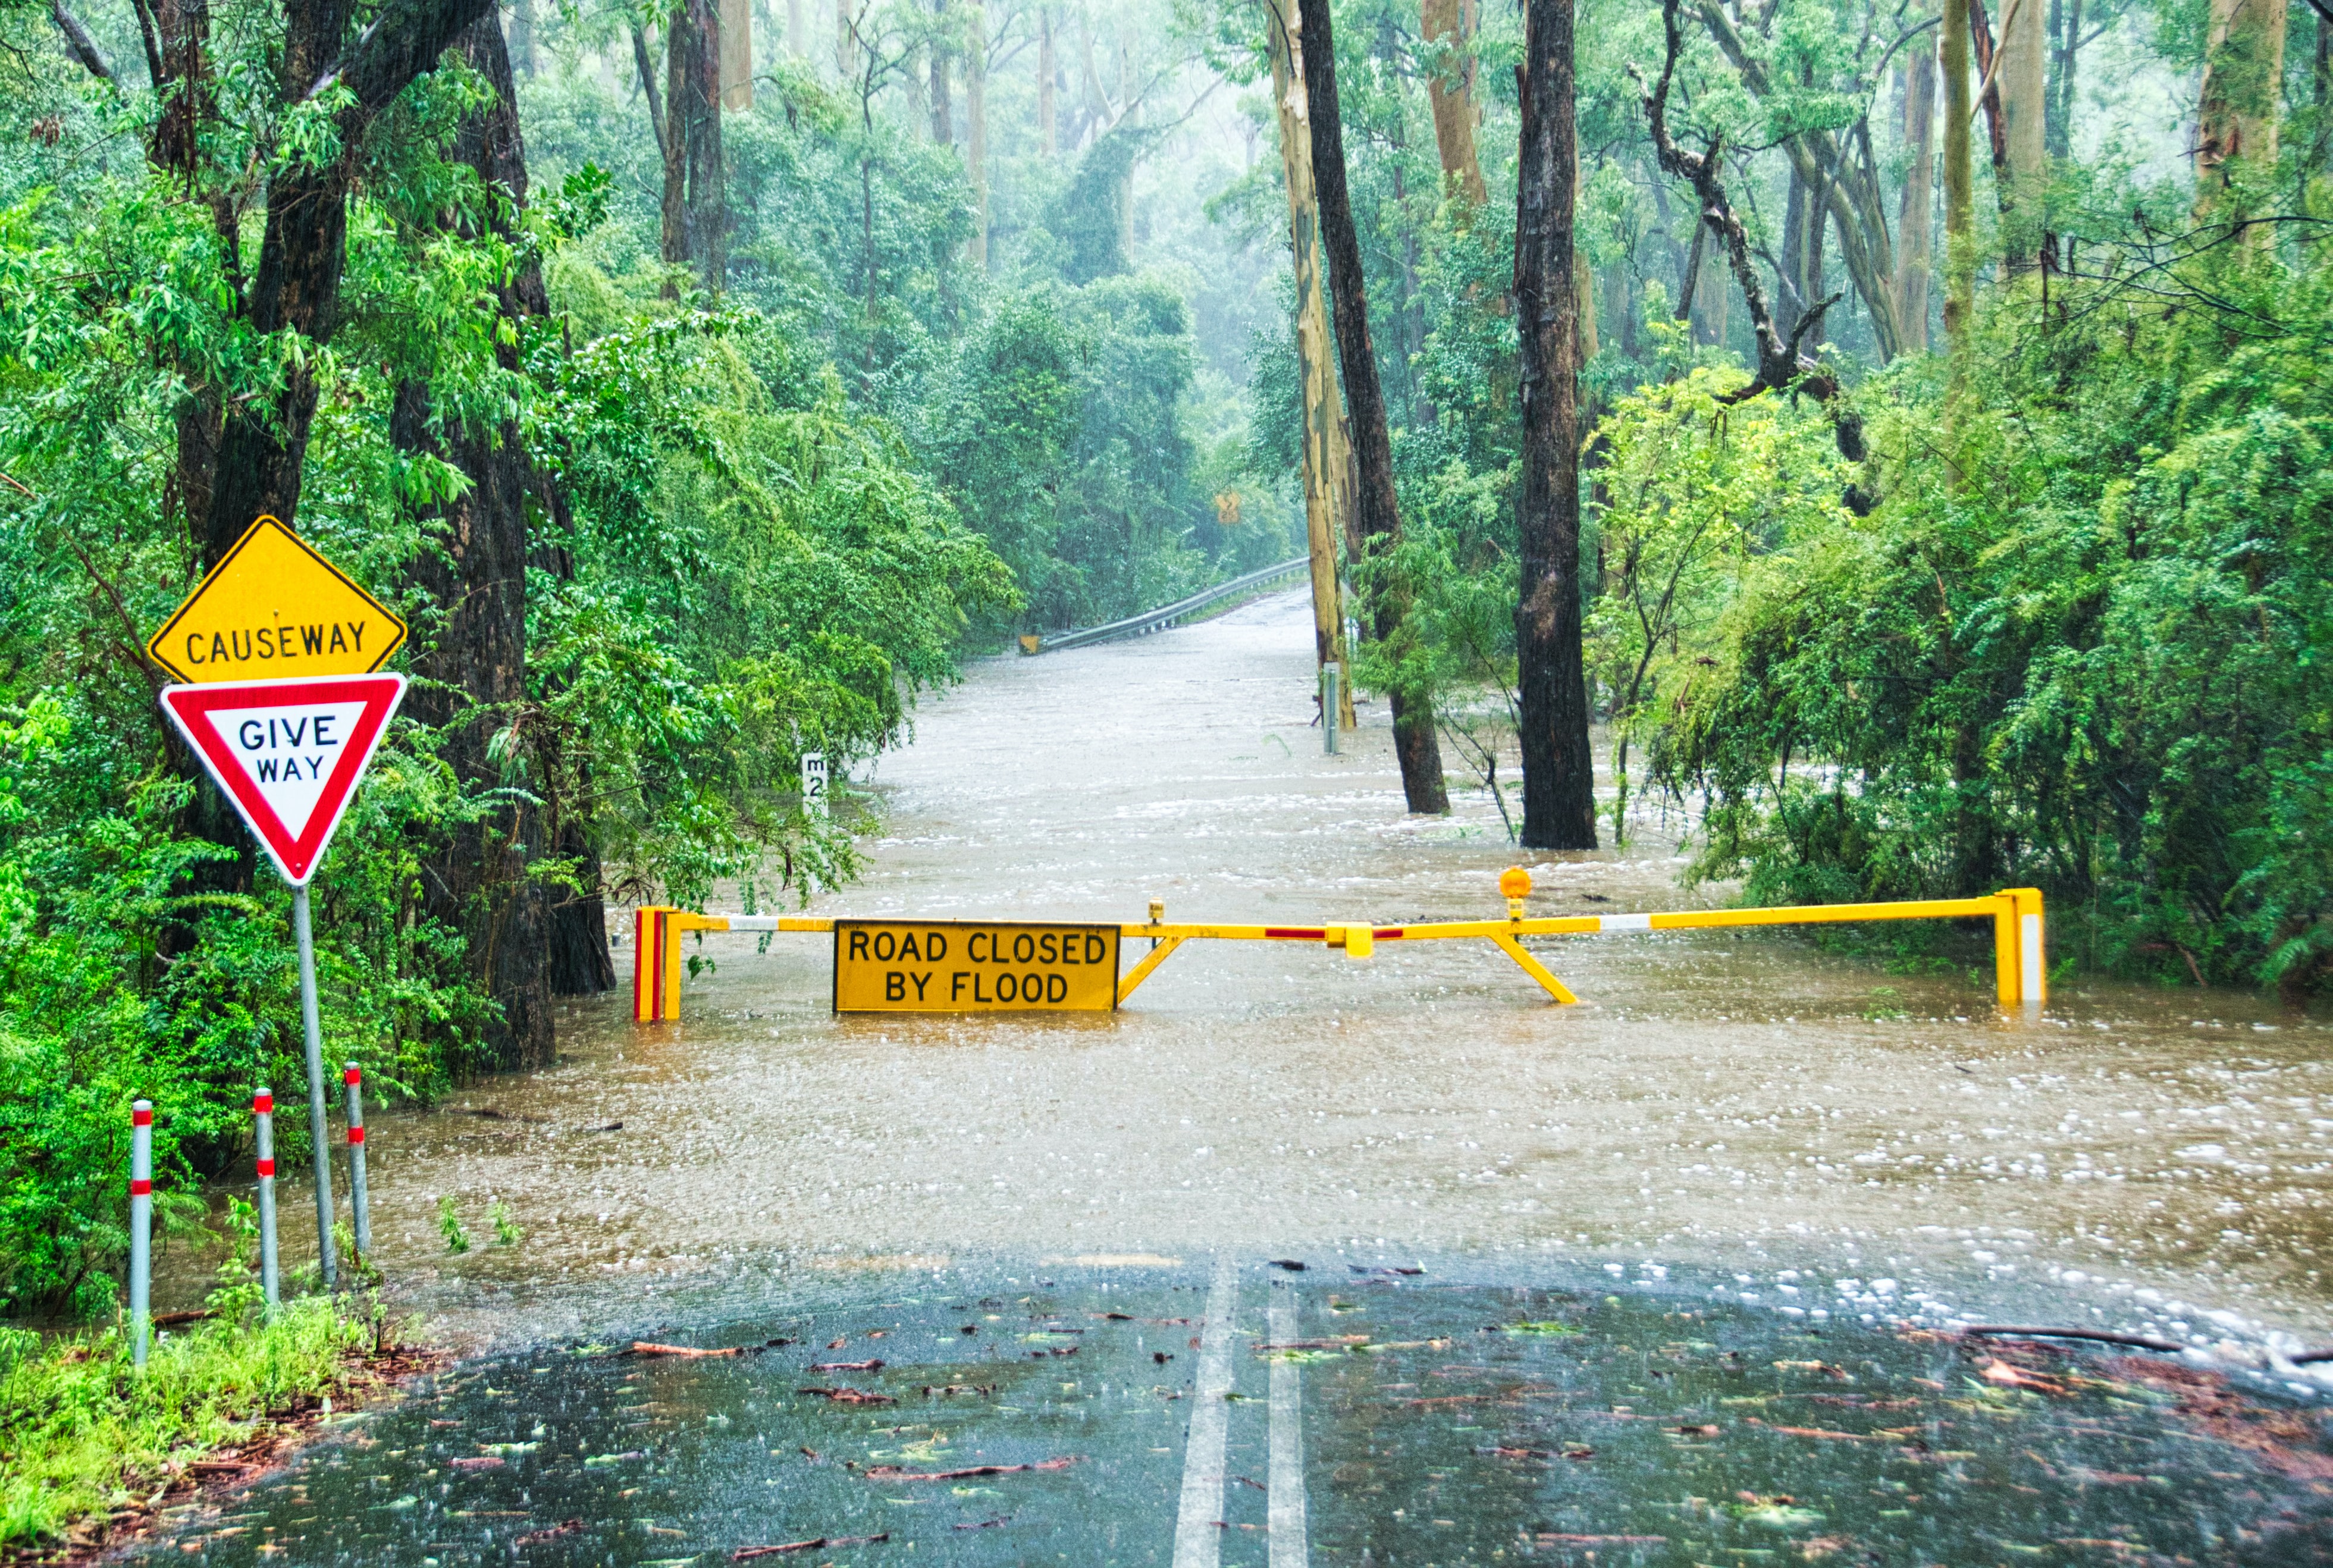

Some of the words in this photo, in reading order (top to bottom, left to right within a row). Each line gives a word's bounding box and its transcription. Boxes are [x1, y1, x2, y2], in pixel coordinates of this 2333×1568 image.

[186, 620, 366, 664] CAUSEWAY
[239, 715, 338, 750] GIVE
[257, 755, 323, 783] WAY
[807, 760, 824, 771] m
[810, 776, 823, 796] 2
[849, 930, 948, 962] ROAD
[967, 932, 1106, 964] CLOSED
[885, 971, 934, 1002] BY
[951, 971, 1068, 1003] FLOOD
